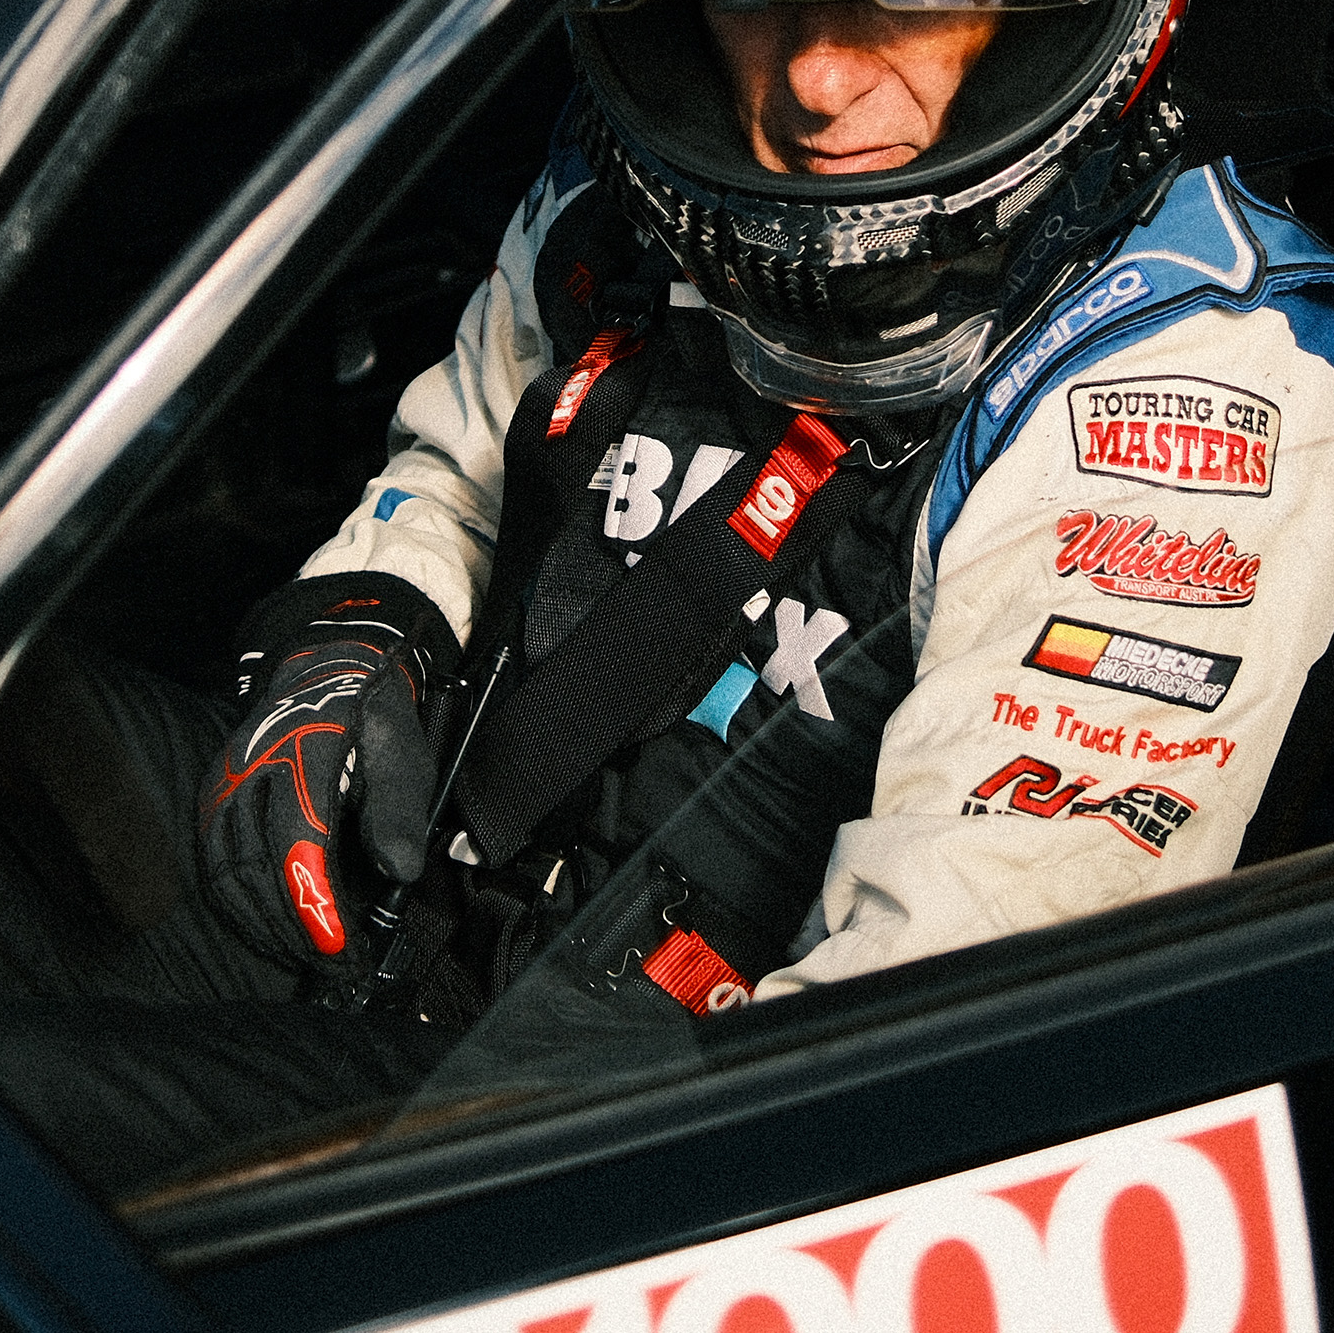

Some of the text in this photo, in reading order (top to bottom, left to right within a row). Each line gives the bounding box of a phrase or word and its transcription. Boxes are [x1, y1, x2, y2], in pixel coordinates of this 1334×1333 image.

[1089, 391, 1269, 438] TOURING CAR
[1084, 421, 1268, 487] MASTERS
[1054, 510, 1262, 594] Whiteline
[1113, 577, 1177, 598] TRANSPORT
[1090, 655, 1227, 707] MOTORSPORT
[1104, 634, 1215, 681] MIEDECKE
[993, 693, 1236, 768] The Truck Factory
